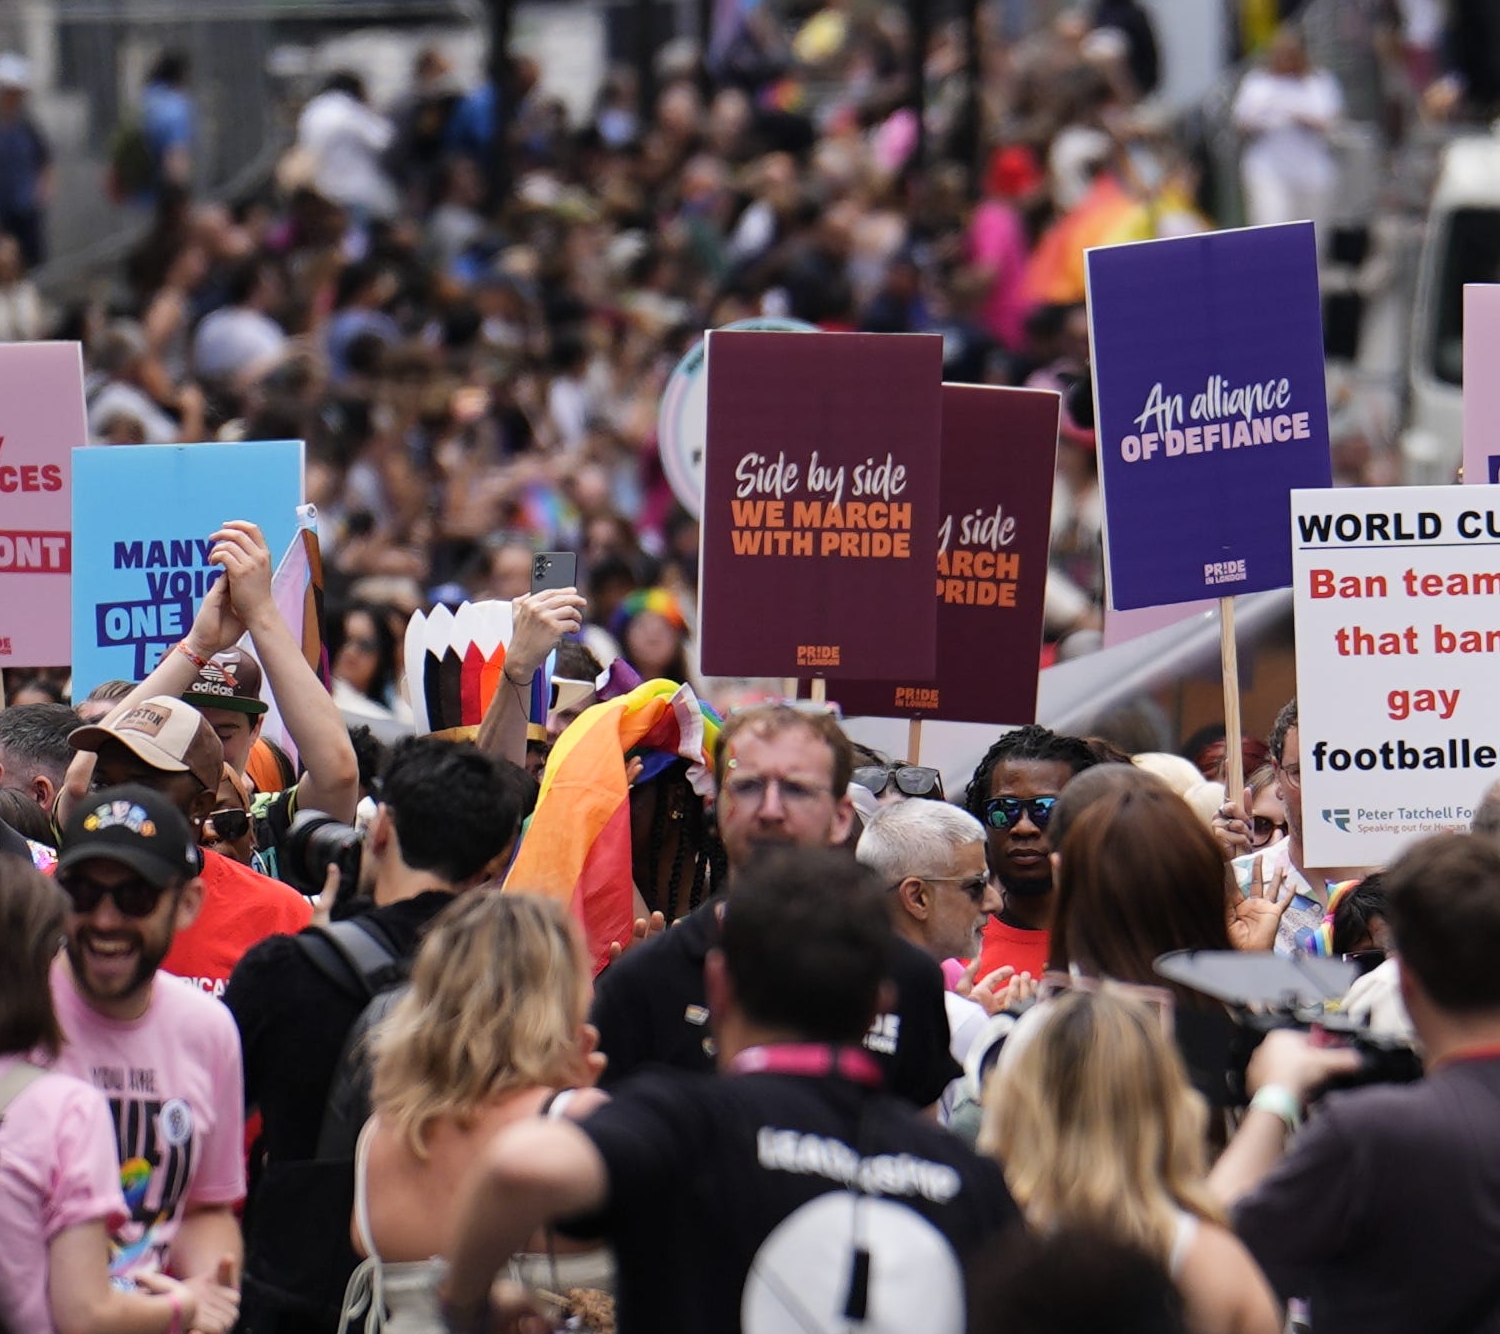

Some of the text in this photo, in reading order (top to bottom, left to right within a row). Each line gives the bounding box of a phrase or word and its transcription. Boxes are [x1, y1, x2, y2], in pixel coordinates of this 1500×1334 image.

[1133, 374, 1291, 441] An alliance
[1120, 411, 1311, 463] OF DEFIANCE
[735, 450, 907, 509] Side by side
[731, 500, 912, 530] WE MARCH
[959, 504, 1017, 551] side
[1298, 512, 1442, 543] WORLD
[113, 540, 217, 569] MANY
[731, 530, 911, 558] WITH PRIDE
[1215, 571, 1247, 584] LONDON
[1309, 569, 1388, 599] Ban
[104, 603, 183, 641] ONE
[1335, 625, 1419, 656] that
[807, 658, 840, 666] LONDON
[191, 682, 235, 697] adidas
[1387, 689, 1461, 721] gay
[1357, 808, 1394, 821] Peter
[1398, 806, 1453, 820] Tatchell
[1357, 823, 1399, 835] Speaking
[1402, 824, 1417, 833] out
[1419, 822, 1431, 832] for
